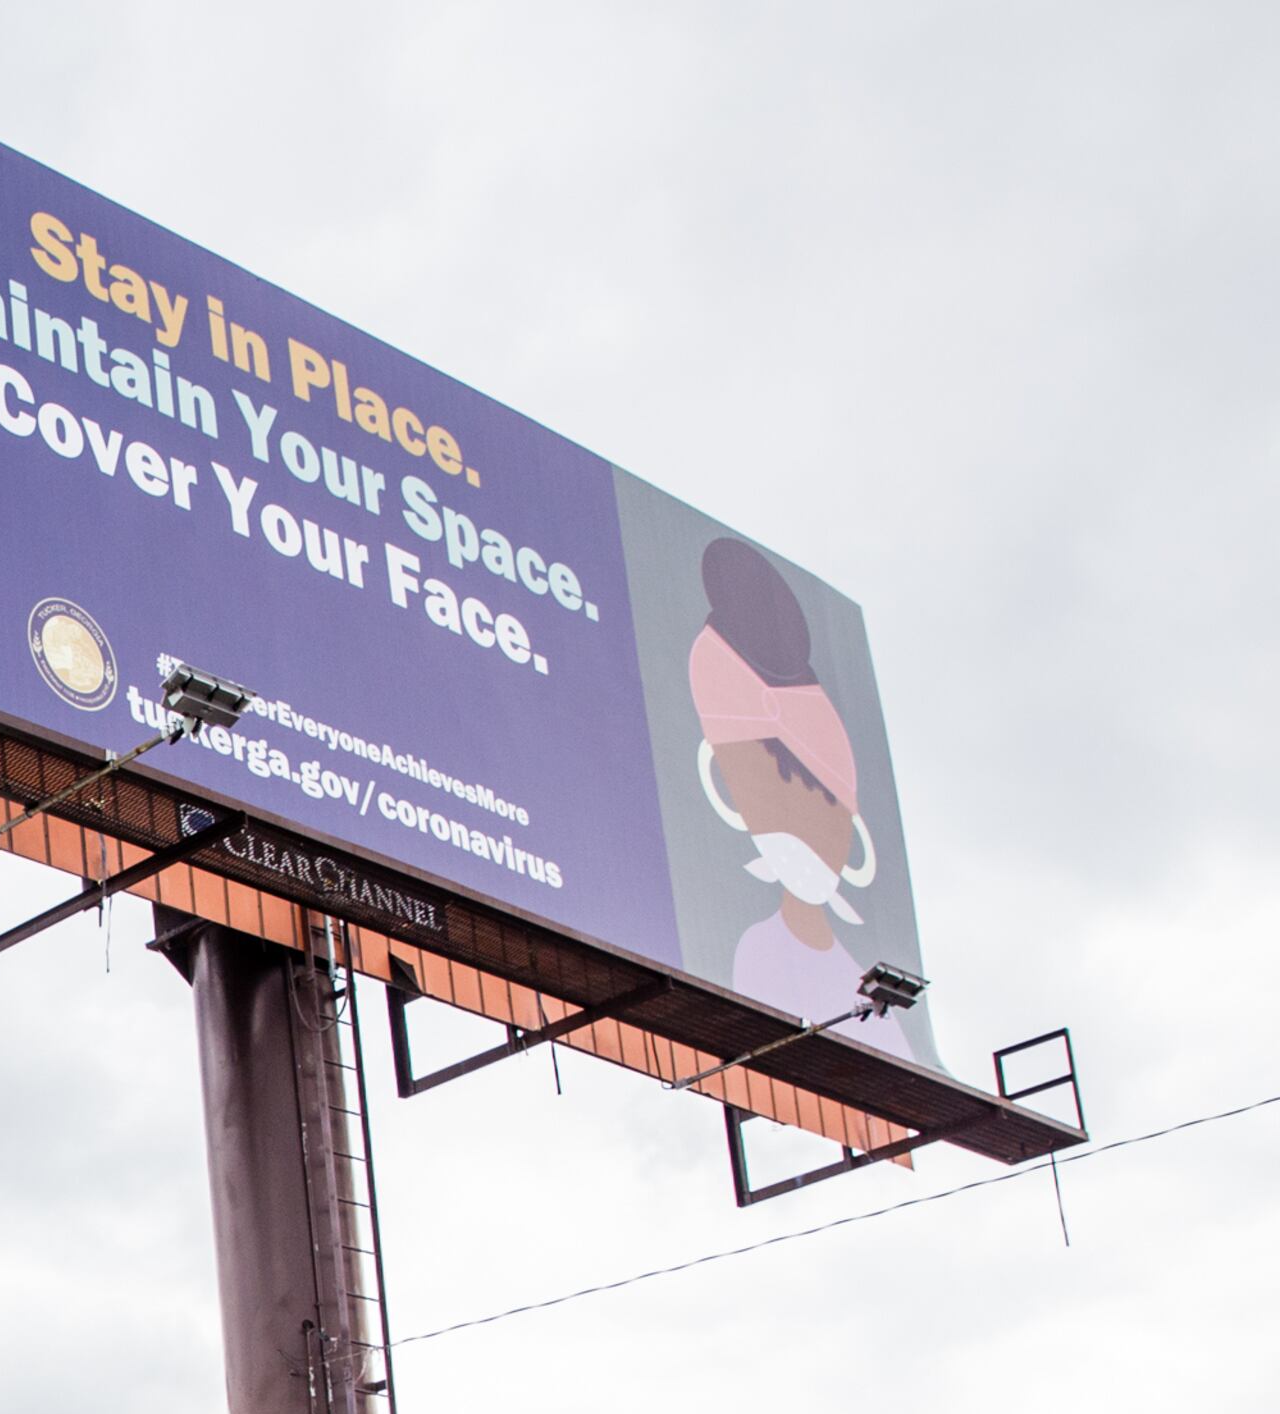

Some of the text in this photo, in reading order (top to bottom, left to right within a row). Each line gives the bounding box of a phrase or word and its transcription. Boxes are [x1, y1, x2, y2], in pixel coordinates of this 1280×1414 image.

[30, 212, 482, 488] Stay in Place.
[211, 461, 369, 588] Your
[387, 544, 549, 676] Face.
[232, 389, 385, 516] Your
[401, 477, 600, 622] Space.
[315, 855, 443, 931] CHANNEL
